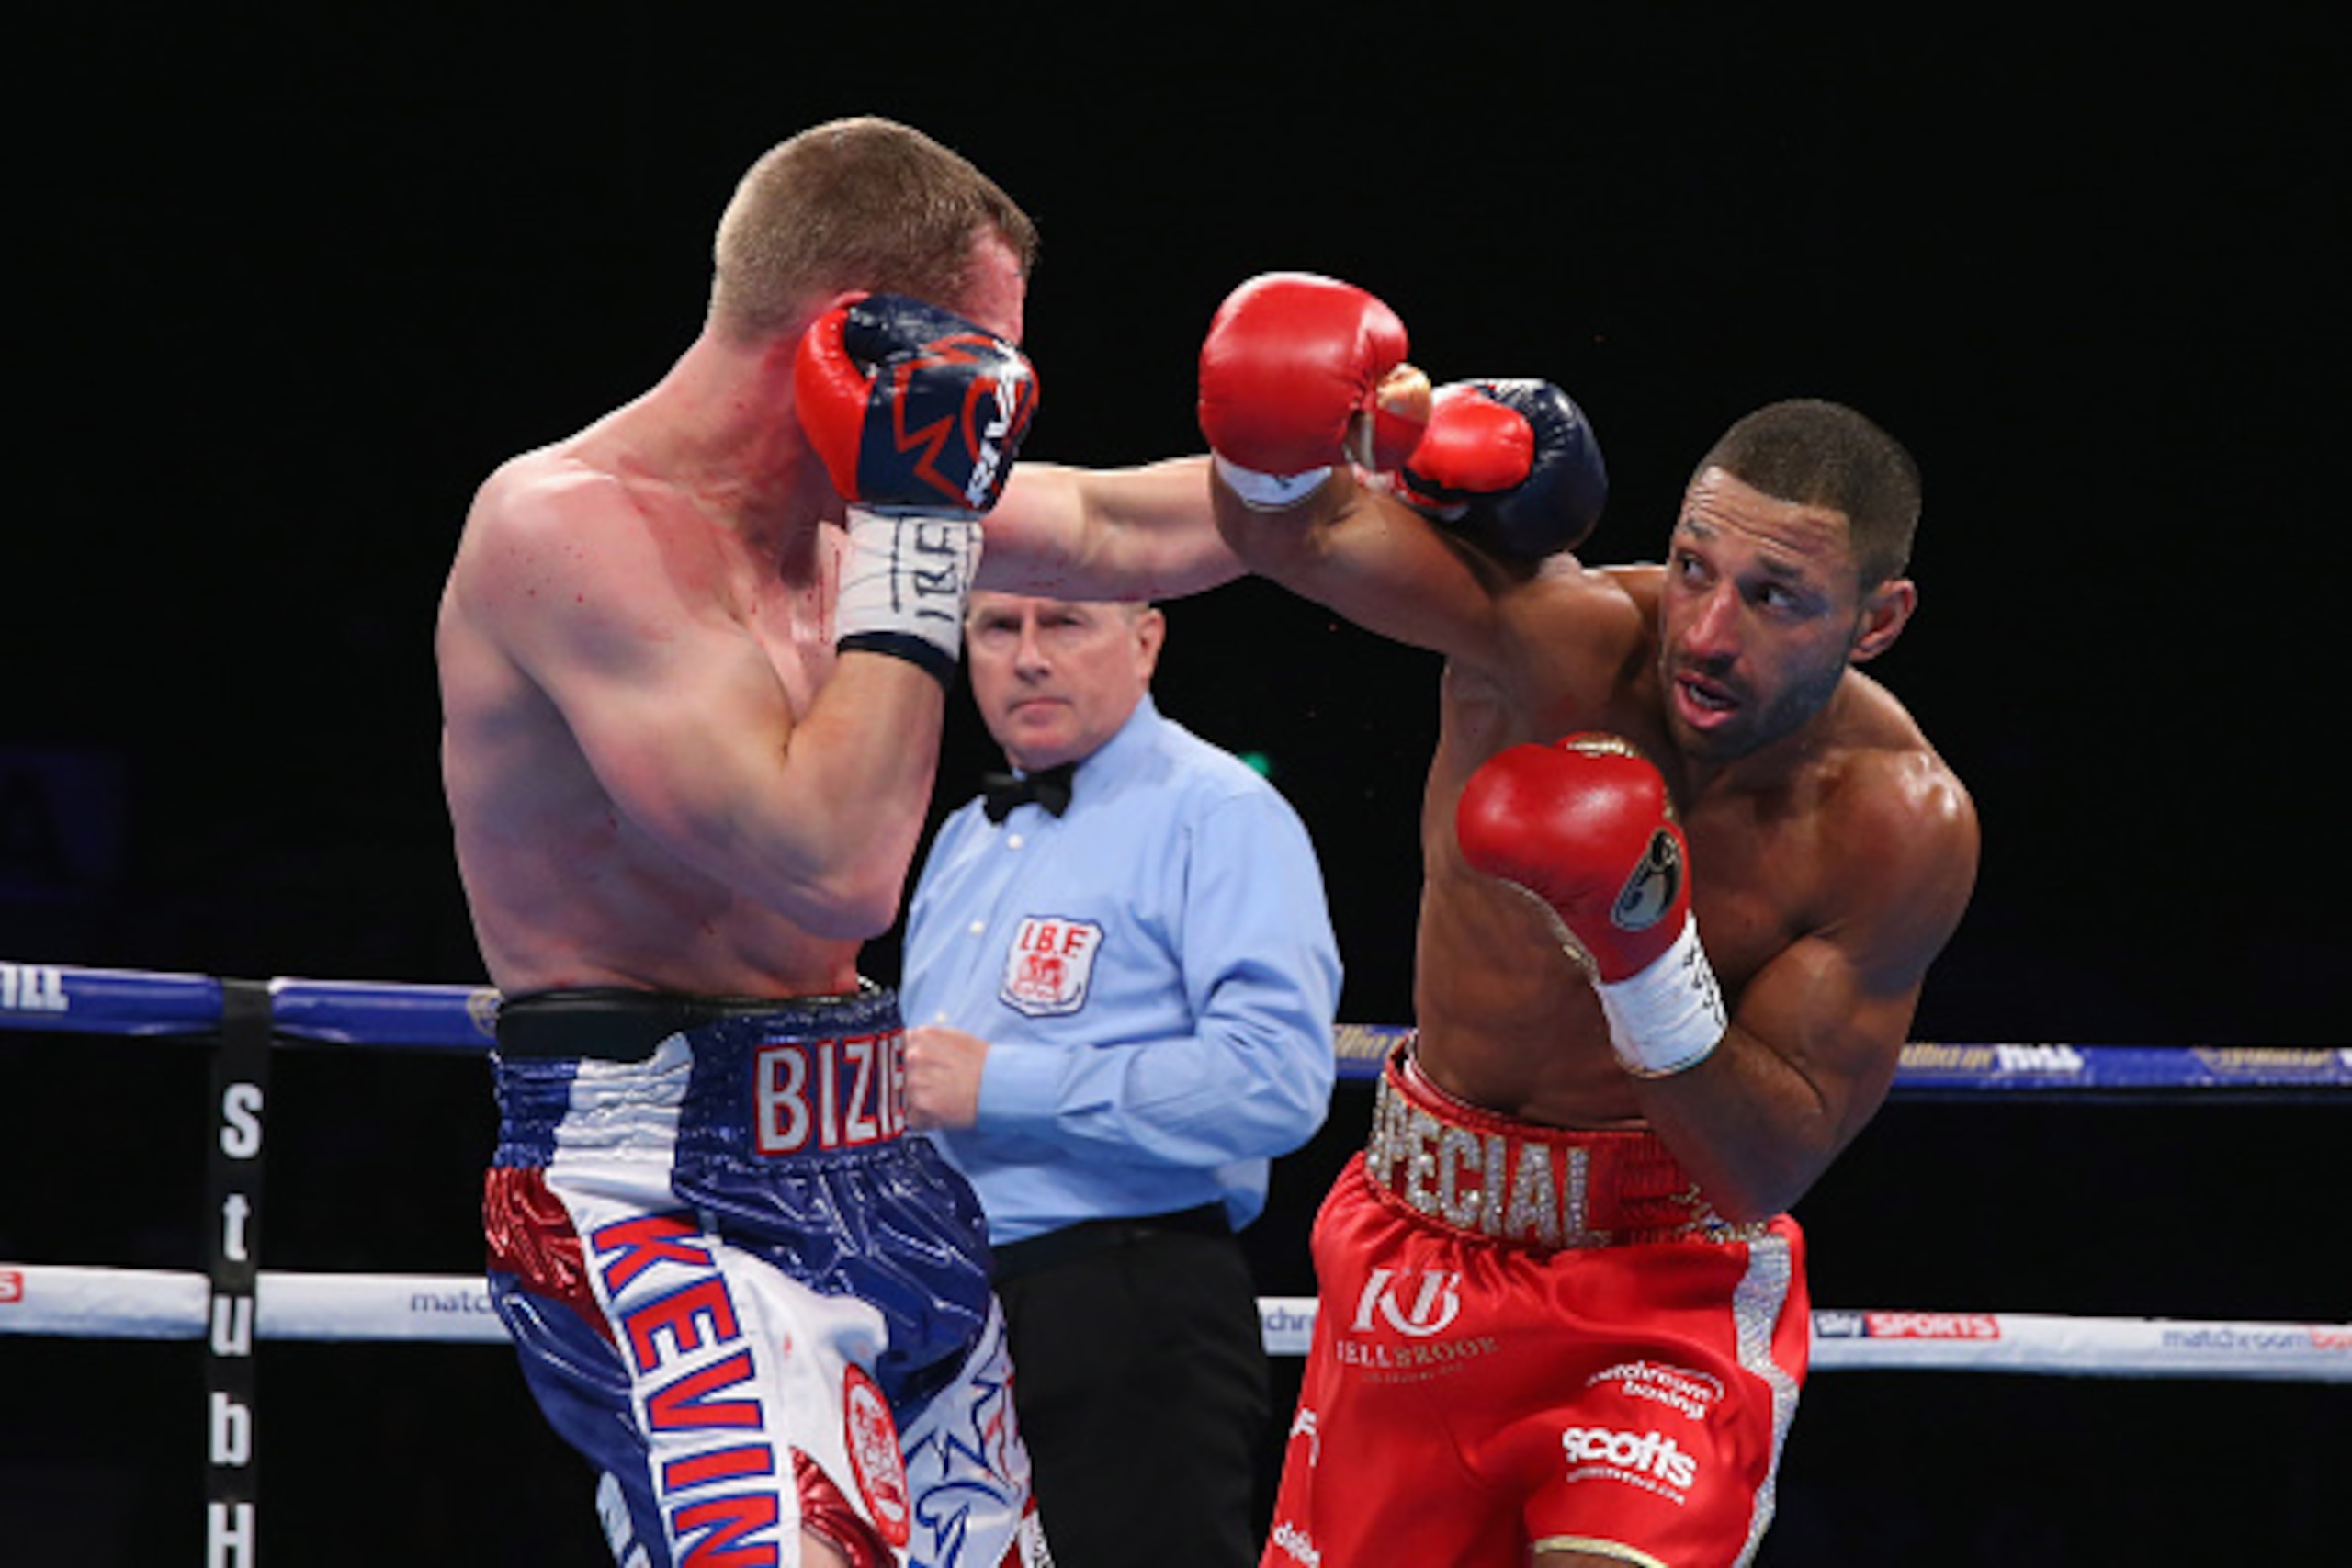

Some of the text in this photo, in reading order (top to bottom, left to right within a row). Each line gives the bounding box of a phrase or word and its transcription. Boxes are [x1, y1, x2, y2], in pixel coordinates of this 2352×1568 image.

[1871, 1315, 1997, 1337] SPORTS
[593, 1209, 781, 1568] KEVIN
[1562, 1427, 1698, 1489] scotts
